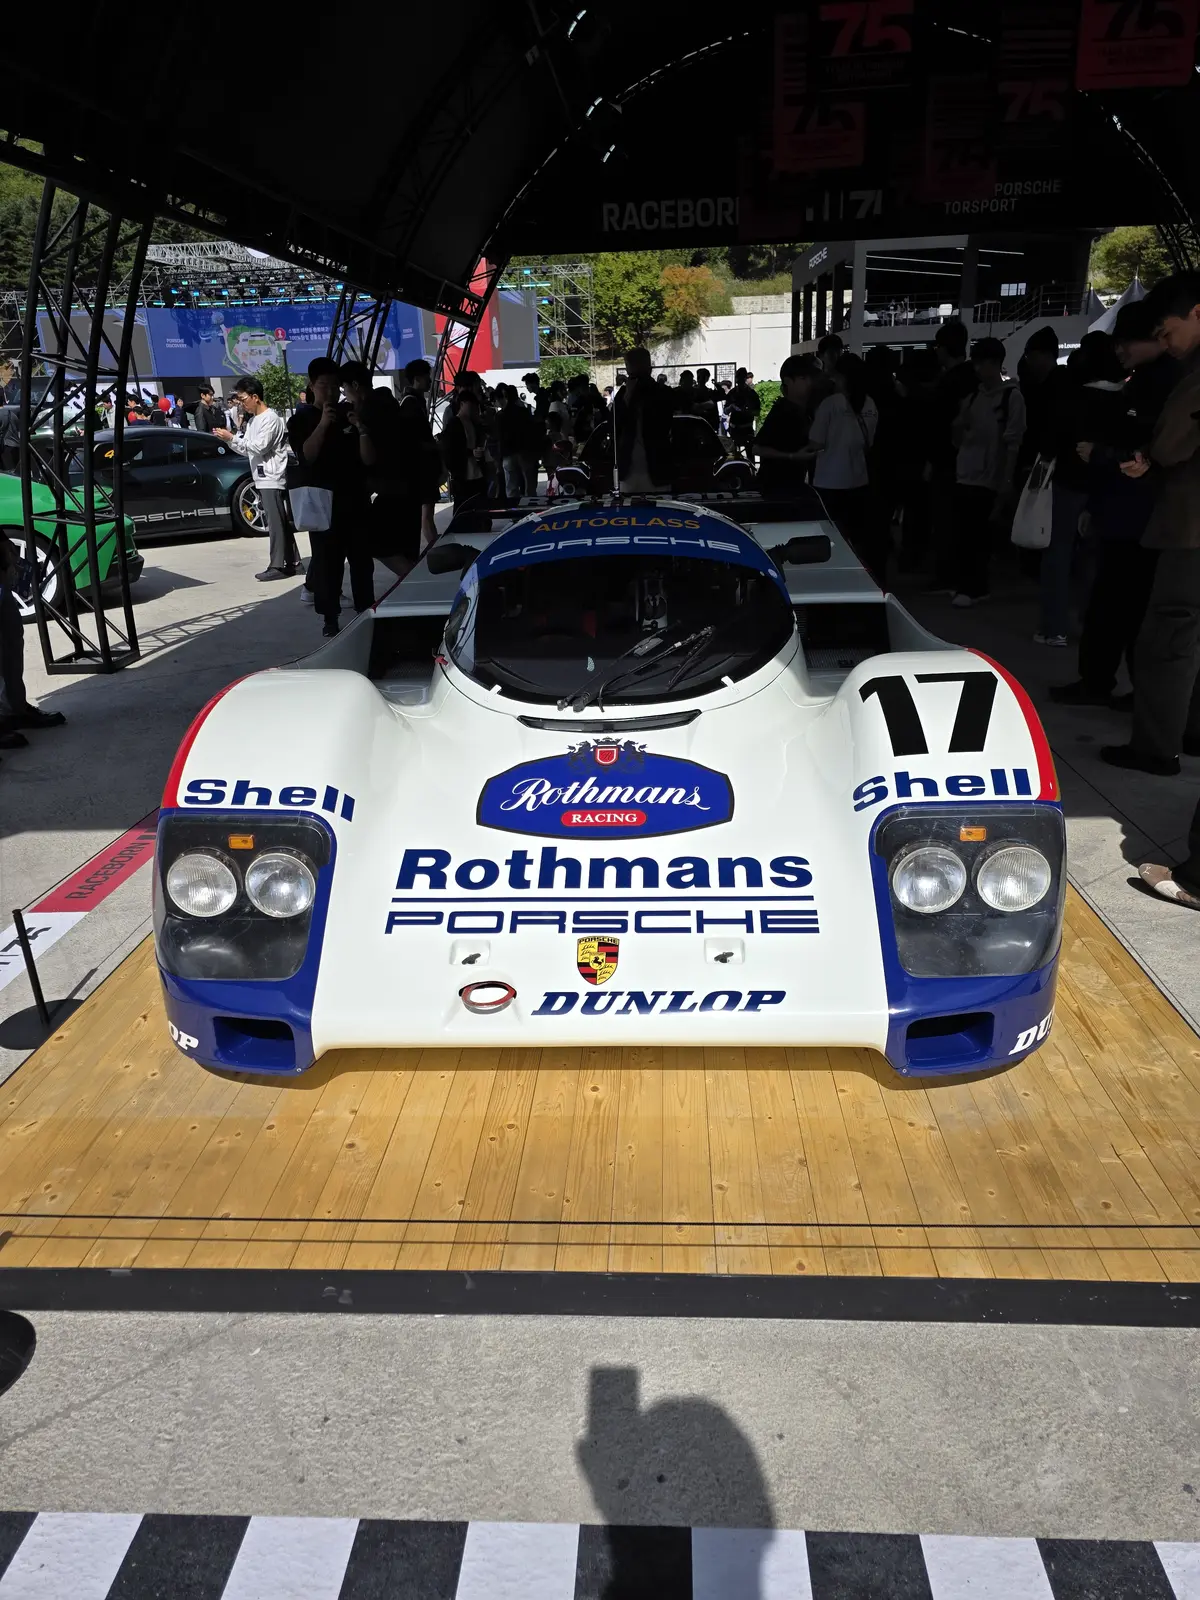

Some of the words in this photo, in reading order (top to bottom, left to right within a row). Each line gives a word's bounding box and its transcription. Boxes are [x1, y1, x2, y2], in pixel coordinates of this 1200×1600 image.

[818, 0, 913, 56] 75
[999, 79, 1067, 121] 75
[994, 179, 1062, 196] PORSCHE
[602, 197, 740, 232] RACEBOR
[532, 516, 701, 534] AUTOGLASS
[488, 536, 741, 566] PORSCHE
[859, 672, 998, 757] 17
[184, 779, 355, 817] Shell
[500, 777, 711, 812] Rothmans
[853, 768, 1031, 812] Shell
[571, 812, 638, 826] RACING
[65, 842, 150, 899] RACEBORN
[396, 847, 813, 891] Rothmans
[385, 909, 820, 935] PORSCHE
[530, 990, 787, 1016] DUNLOP
